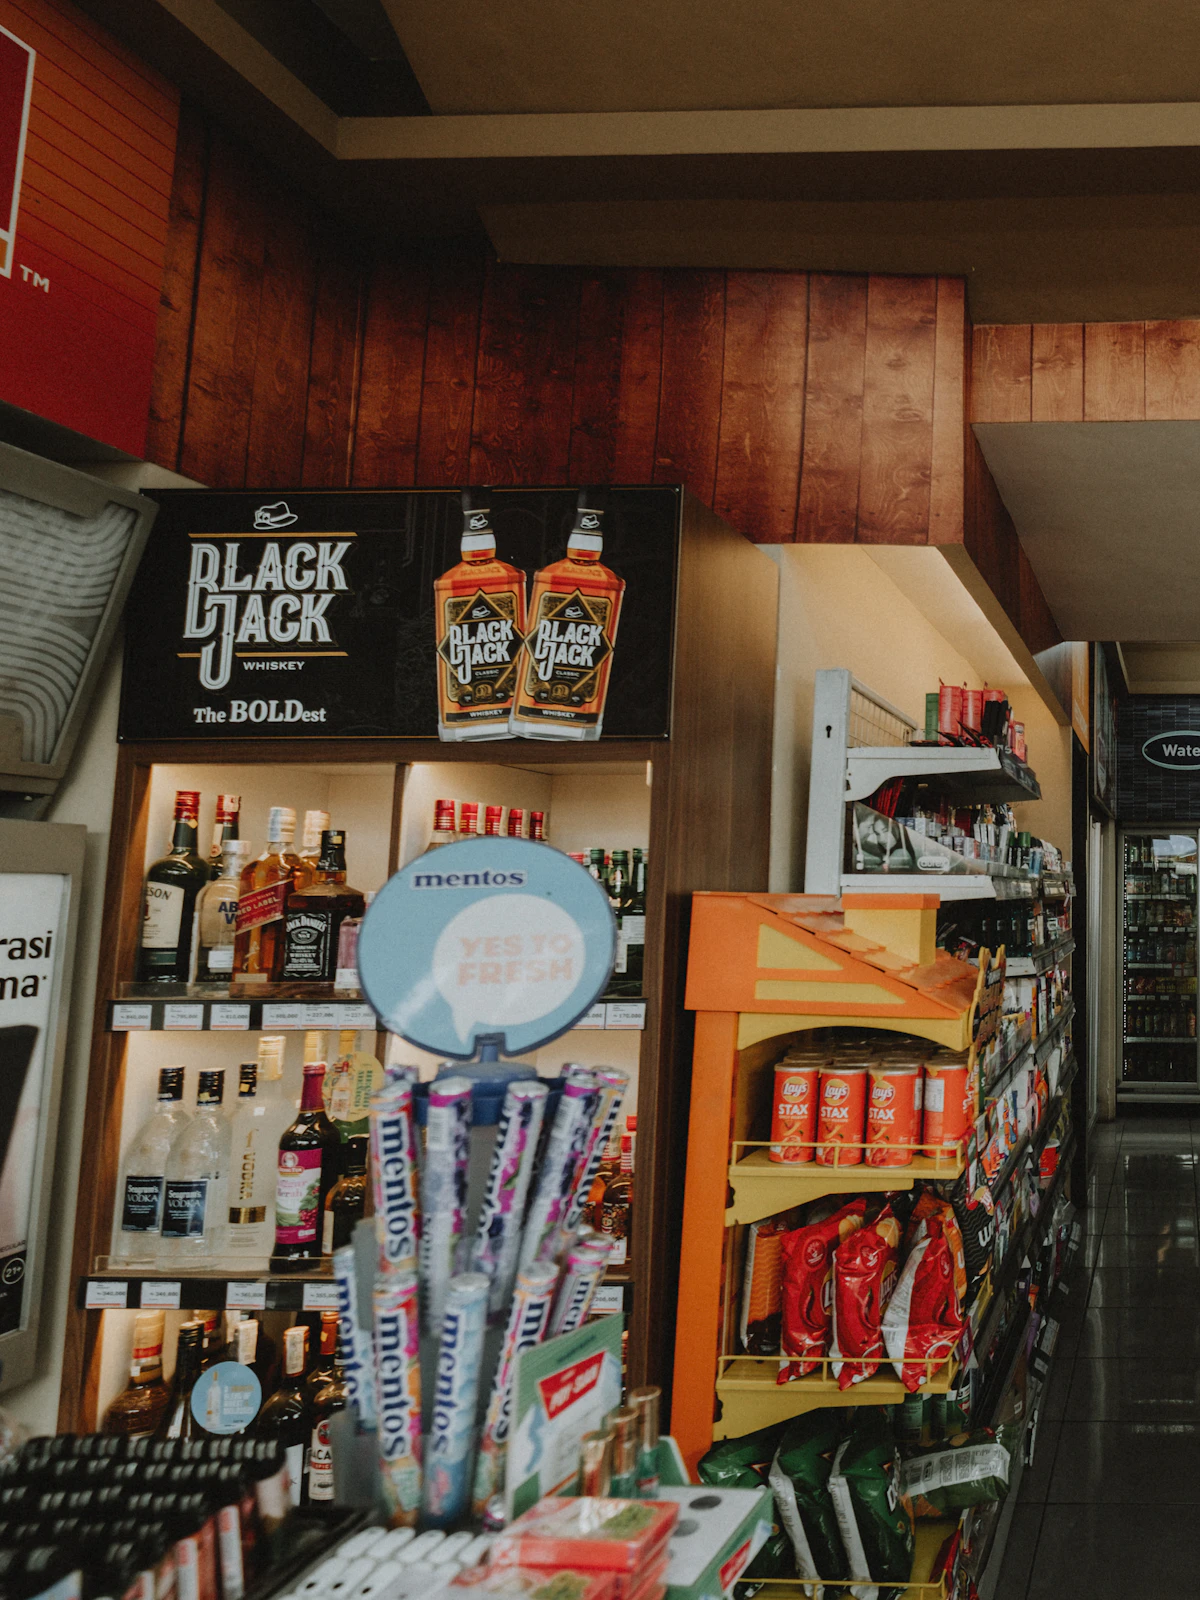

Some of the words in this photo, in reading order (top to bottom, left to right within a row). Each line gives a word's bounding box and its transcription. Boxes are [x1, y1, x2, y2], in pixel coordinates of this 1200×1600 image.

[20, 265, 50, 293] TM
[183, 542, 352, 610] BLACK
[201, 593, 336, 667] JACK
[243, 661, 305, 671] WHISKEY
[194, 708, 227, 723] The
[469, 708, 504, 718] WHISKEY
[542, 709, 577, 719] WHISKEY
[413, 870, 525, 888] mentos
[459, 934, 522, 958] YES
[527, 933, 573, 955] TO
[457, 957, 573, 987] FRESH
[783, 1081, 808, 1097] Lay's
[824, 1085, 849, 1099] Lay's
[871, 1085, 895, 1101] Lay's
[778, 1103, 809, 1115] STAX
[821, 1107, 849, 1119] STAX
[868, 1108, 895, 1120] STAX
[380, 1117, 412, 1260] mentos
[127, 1193, 159, 1202] VODKA
[168, 1199, 201, 1208] VODKA
[5, 1265, 22, 1278] 21+
[379, 1313, 409, 1458] mentos
[433, 1312, 461, 1454] mentos
